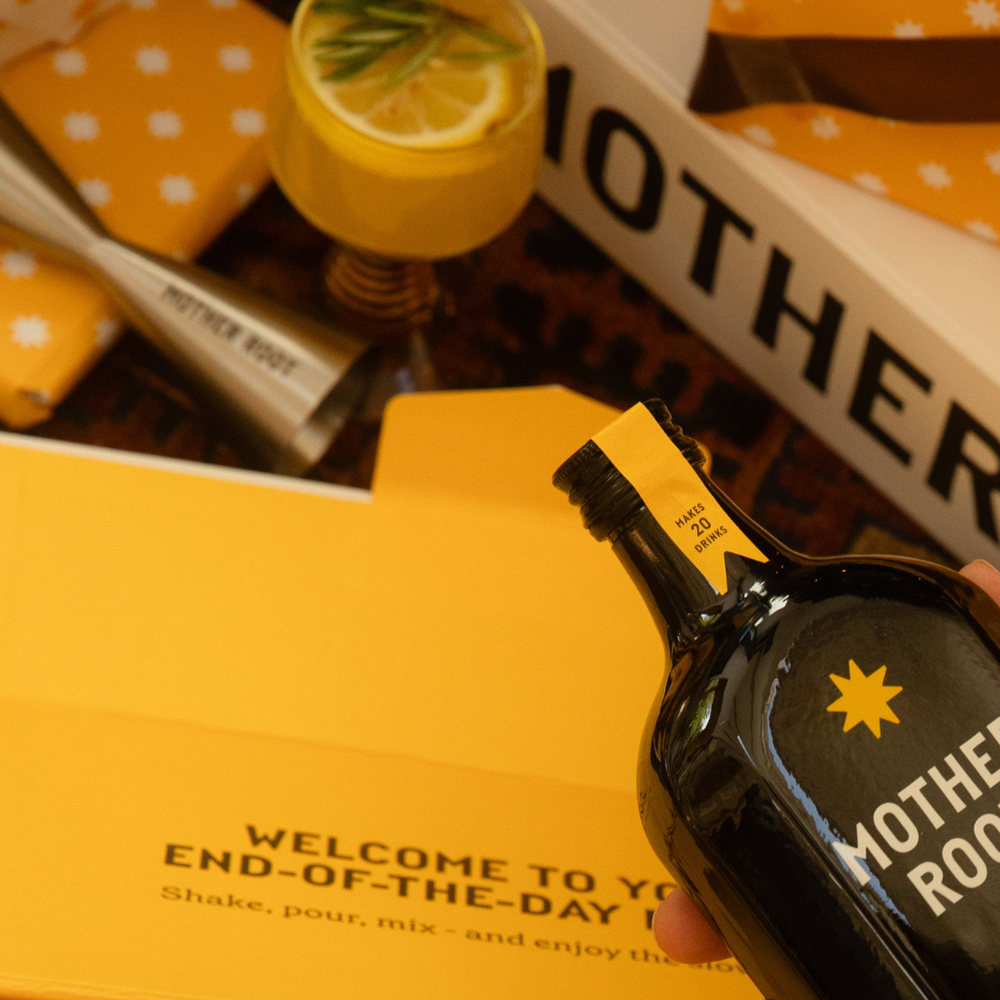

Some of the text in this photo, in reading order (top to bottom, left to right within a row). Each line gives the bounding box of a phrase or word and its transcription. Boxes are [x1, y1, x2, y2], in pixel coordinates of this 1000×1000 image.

[675, 503, 705, 528] MAKES
[691, 517, 711, 537] 20
[694, 526, 728, 553] DRINKS
[246, 824, 508, 883] WELCOME
[528, 864, 595, 893] TO
[164, 843, 621, 925] END-OF-THE-DAY
[160, 885, 273, 914] Shake,
[283, 905, 367, 927] pour,
[377, 917, 437, 936] mix
[465, 930, 525, 946] and
[534, 939, 622, 962] enjoy
